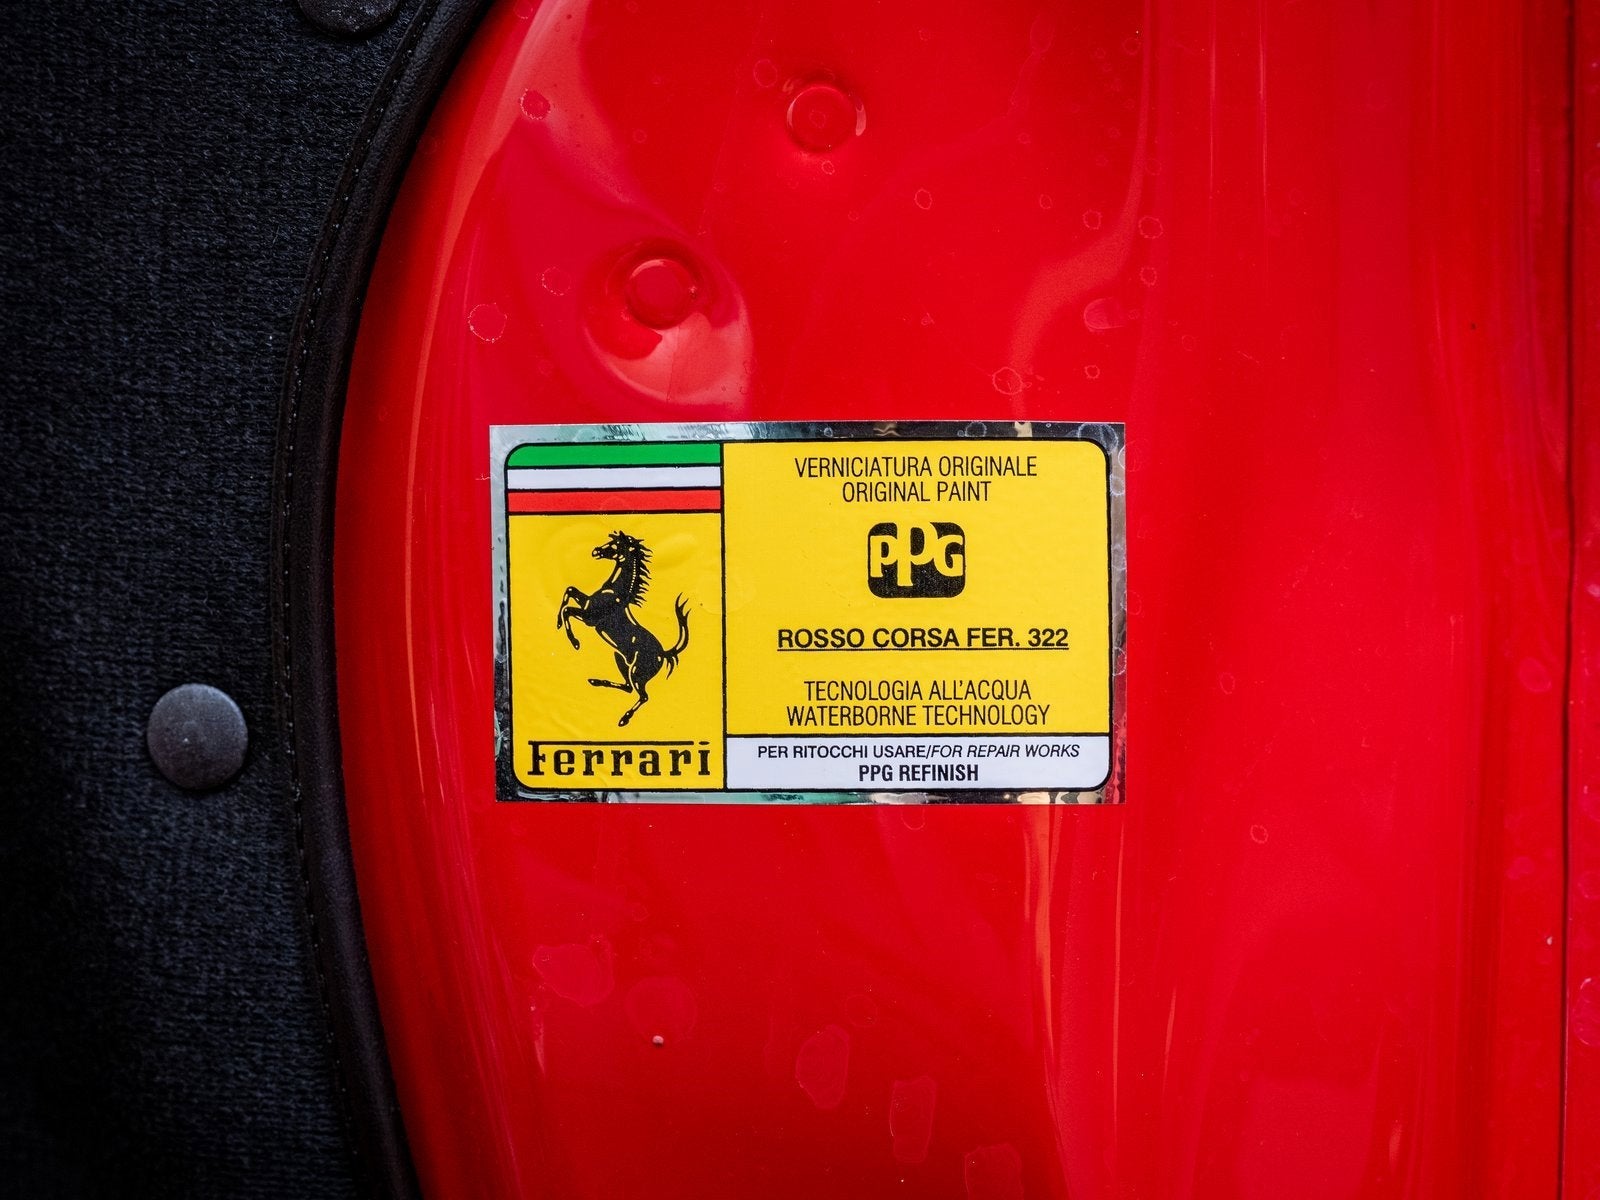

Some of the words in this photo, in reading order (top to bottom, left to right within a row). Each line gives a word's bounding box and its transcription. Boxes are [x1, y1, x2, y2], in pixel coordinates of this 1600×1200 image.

[794, 456, 933, 478] VERNICIATURA
[938, 455, 1038, 477] ORIGINALE
[842, 481, 931, 502] ORIGINAL
[937, 480, 992, 502] PAINT
[869, 521, 965, 587] PPG
[777, 627, 864, 649] ROSSO
[872, 627, 960, 648] CORSA
[966, 627, 1021, 648] FER.
[1027, 627, 1069, 648] 322
[804, 680, 923, 702] TECNOLOGIA
[786, 705, 917, 727] WATERBORNE
[922, 704, 1051, 726] TECHNOLOGY
[527, 740, 711, 777] Ferrari
[757, 745, 791, 759] PER
[793, 745, 869, 759] RITOCCHI
[966, 744, 1021, 758] REPAIR
[1024, 744, 1081, 758] WORKS
[858, 764, 894, 782] PPG
[898, 763, 979, 782] REFINISH
